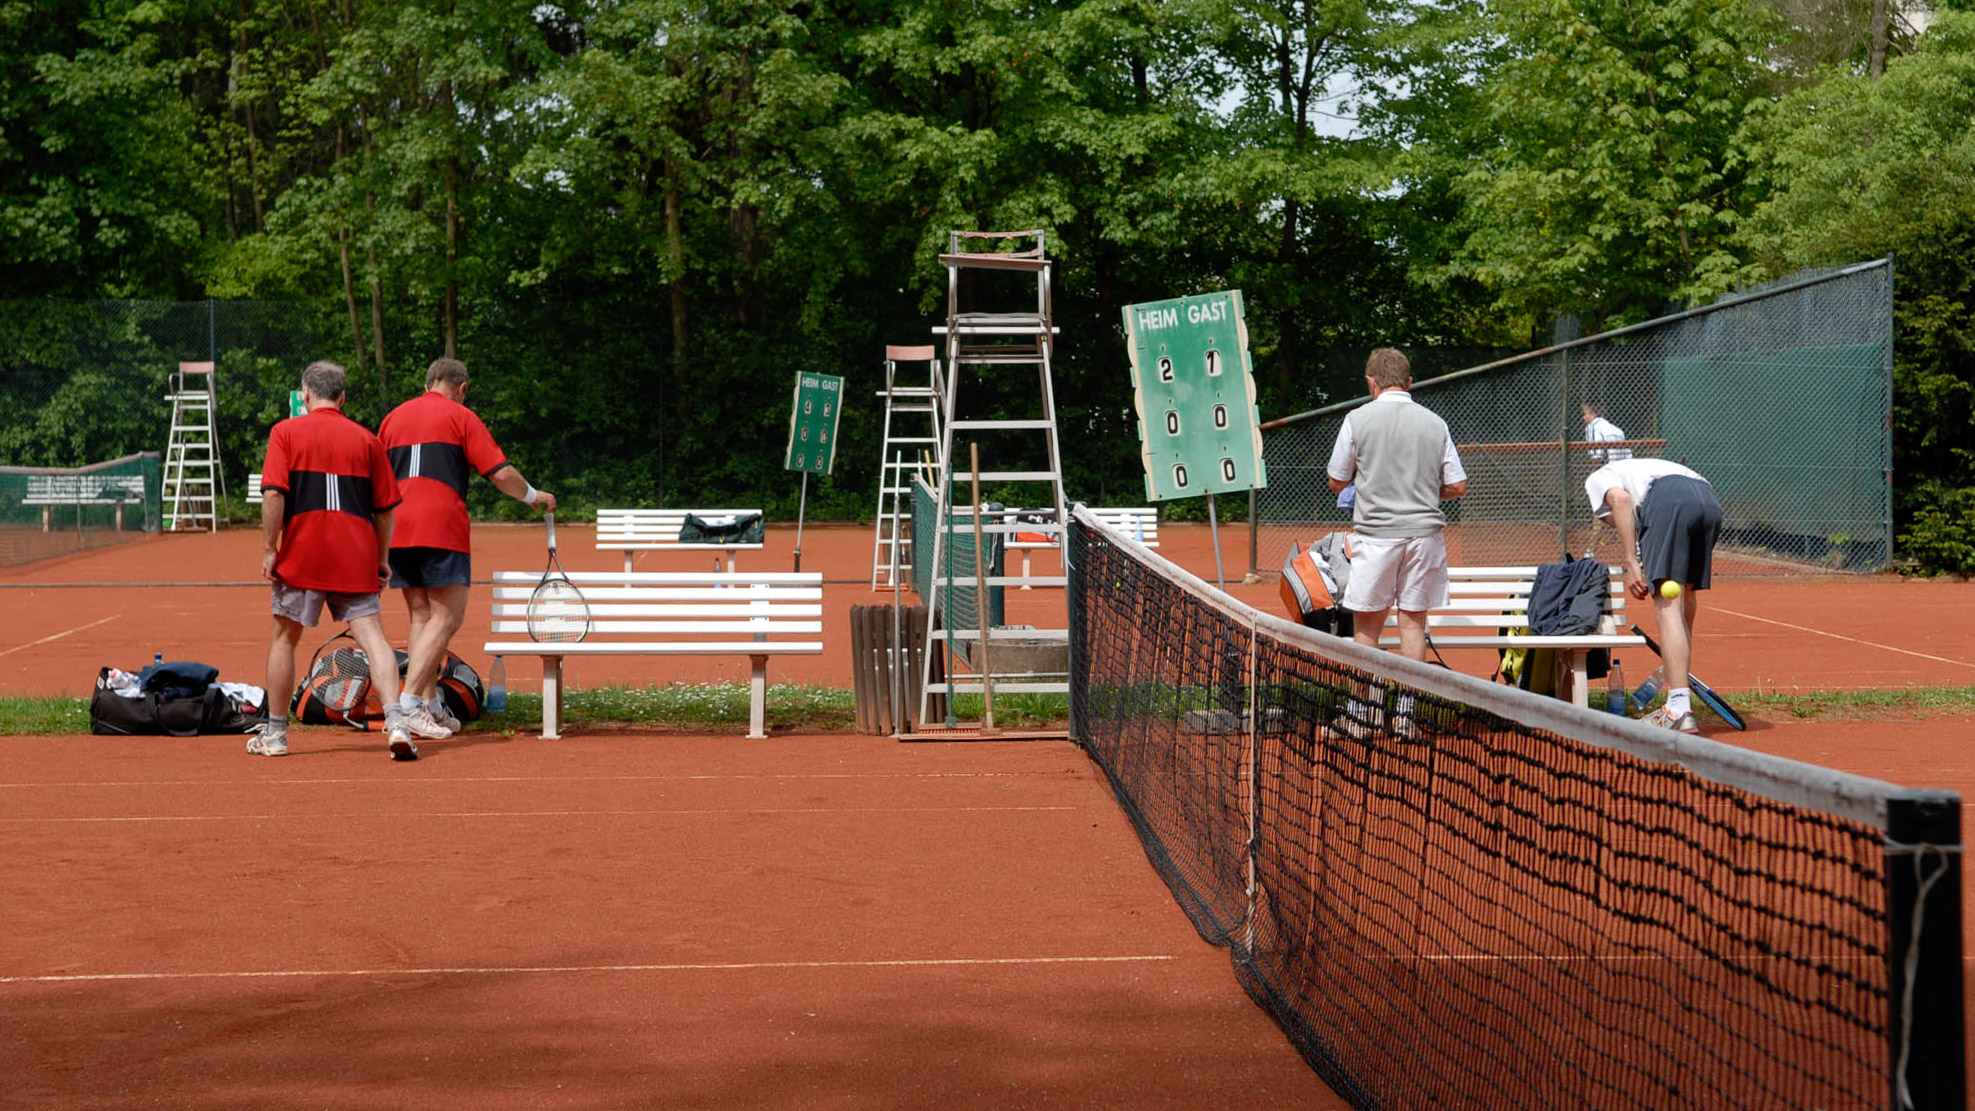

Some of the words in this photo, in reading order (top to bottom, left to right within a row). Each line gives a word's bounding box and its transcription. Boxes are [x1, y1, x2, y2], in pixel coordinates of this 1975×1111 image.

[1138, 307, 1179, 331] HEIM
[1187, 301, 1227, 324] GAST
[1160, 358, 1173, 381] 2
[1206, 350, 1216, 374] 1
[801, 376, 819, 389] HEIM
[822, 379, 838, 391] GAST
[1166, 412, 1179, 434] 0
[1214, 405, 1227, 428] 0
[1176, 465, 1188, 487] 0
[1223, 459, 1236, 482] 0
